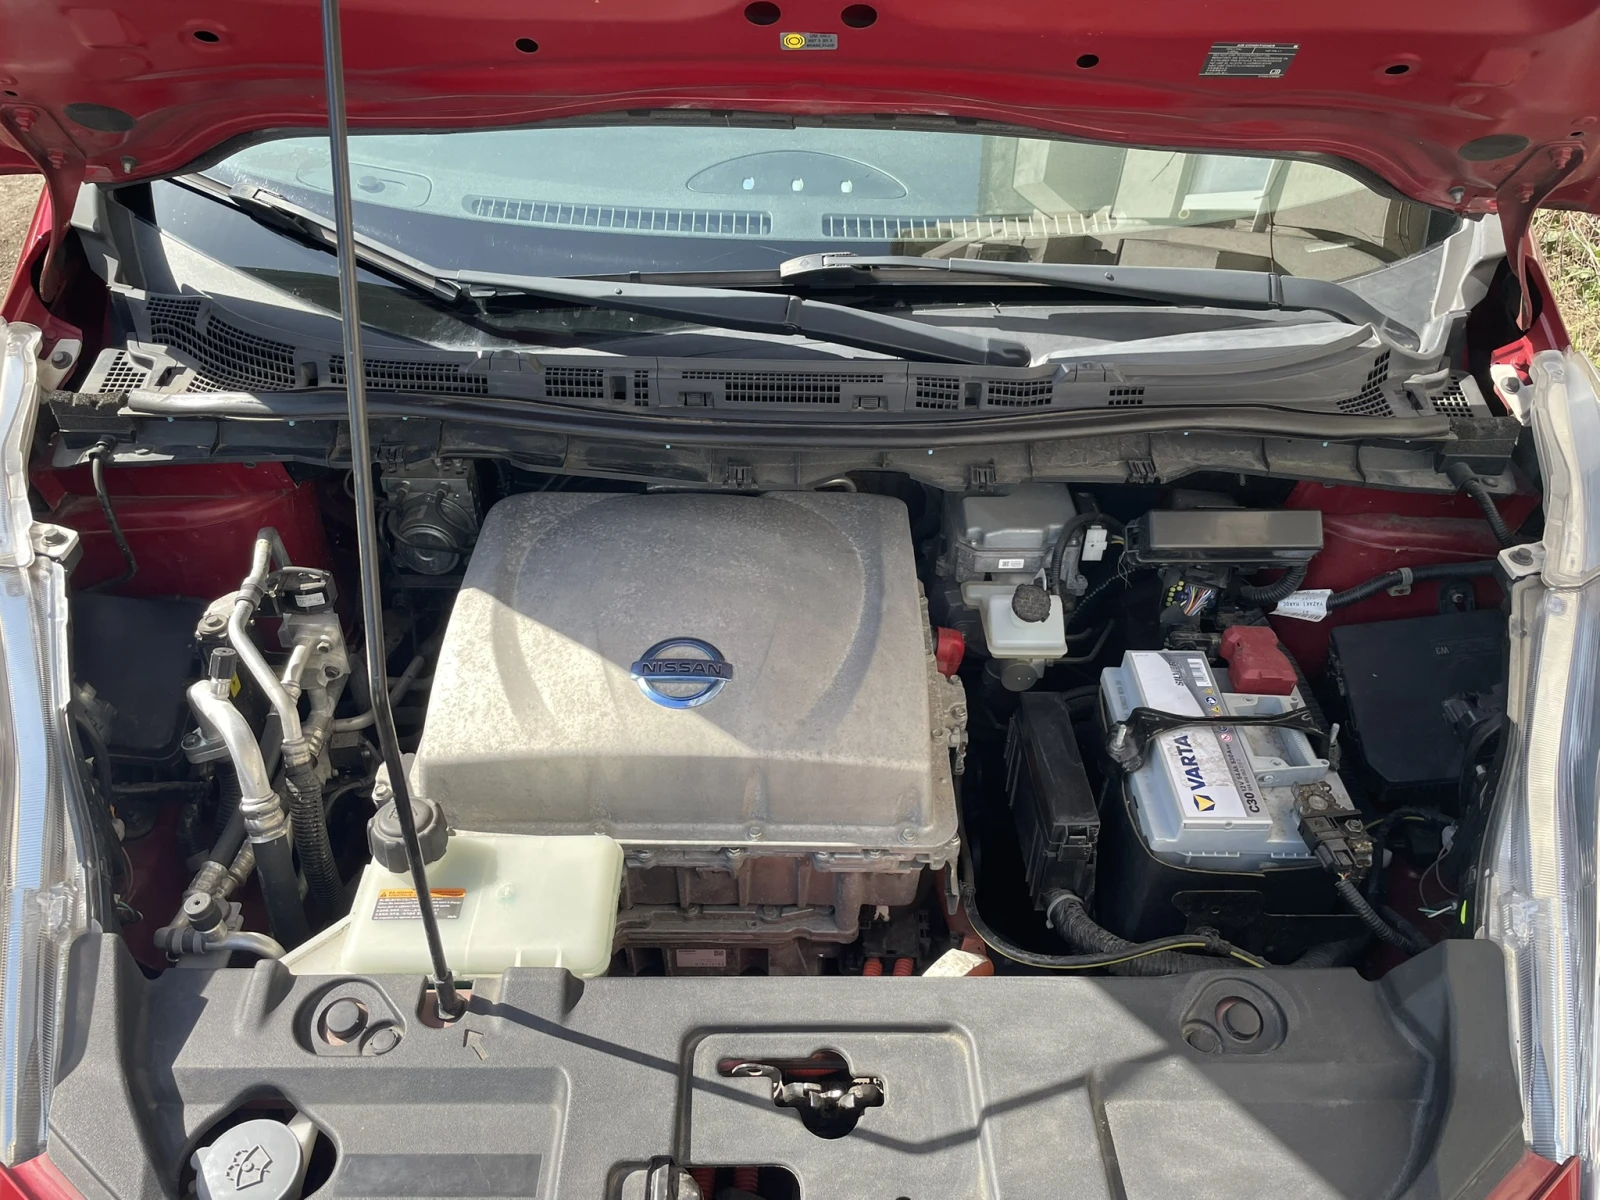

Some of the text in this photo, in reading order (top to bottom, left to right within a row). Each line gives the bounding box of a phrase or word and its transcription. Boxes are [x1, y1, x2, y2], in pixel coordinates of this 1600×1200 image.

[642, 662, 722, 675] NISSAN
[1173, 735, 1206, 791] VARTA
[1244, 792, 1260, 813] C30
